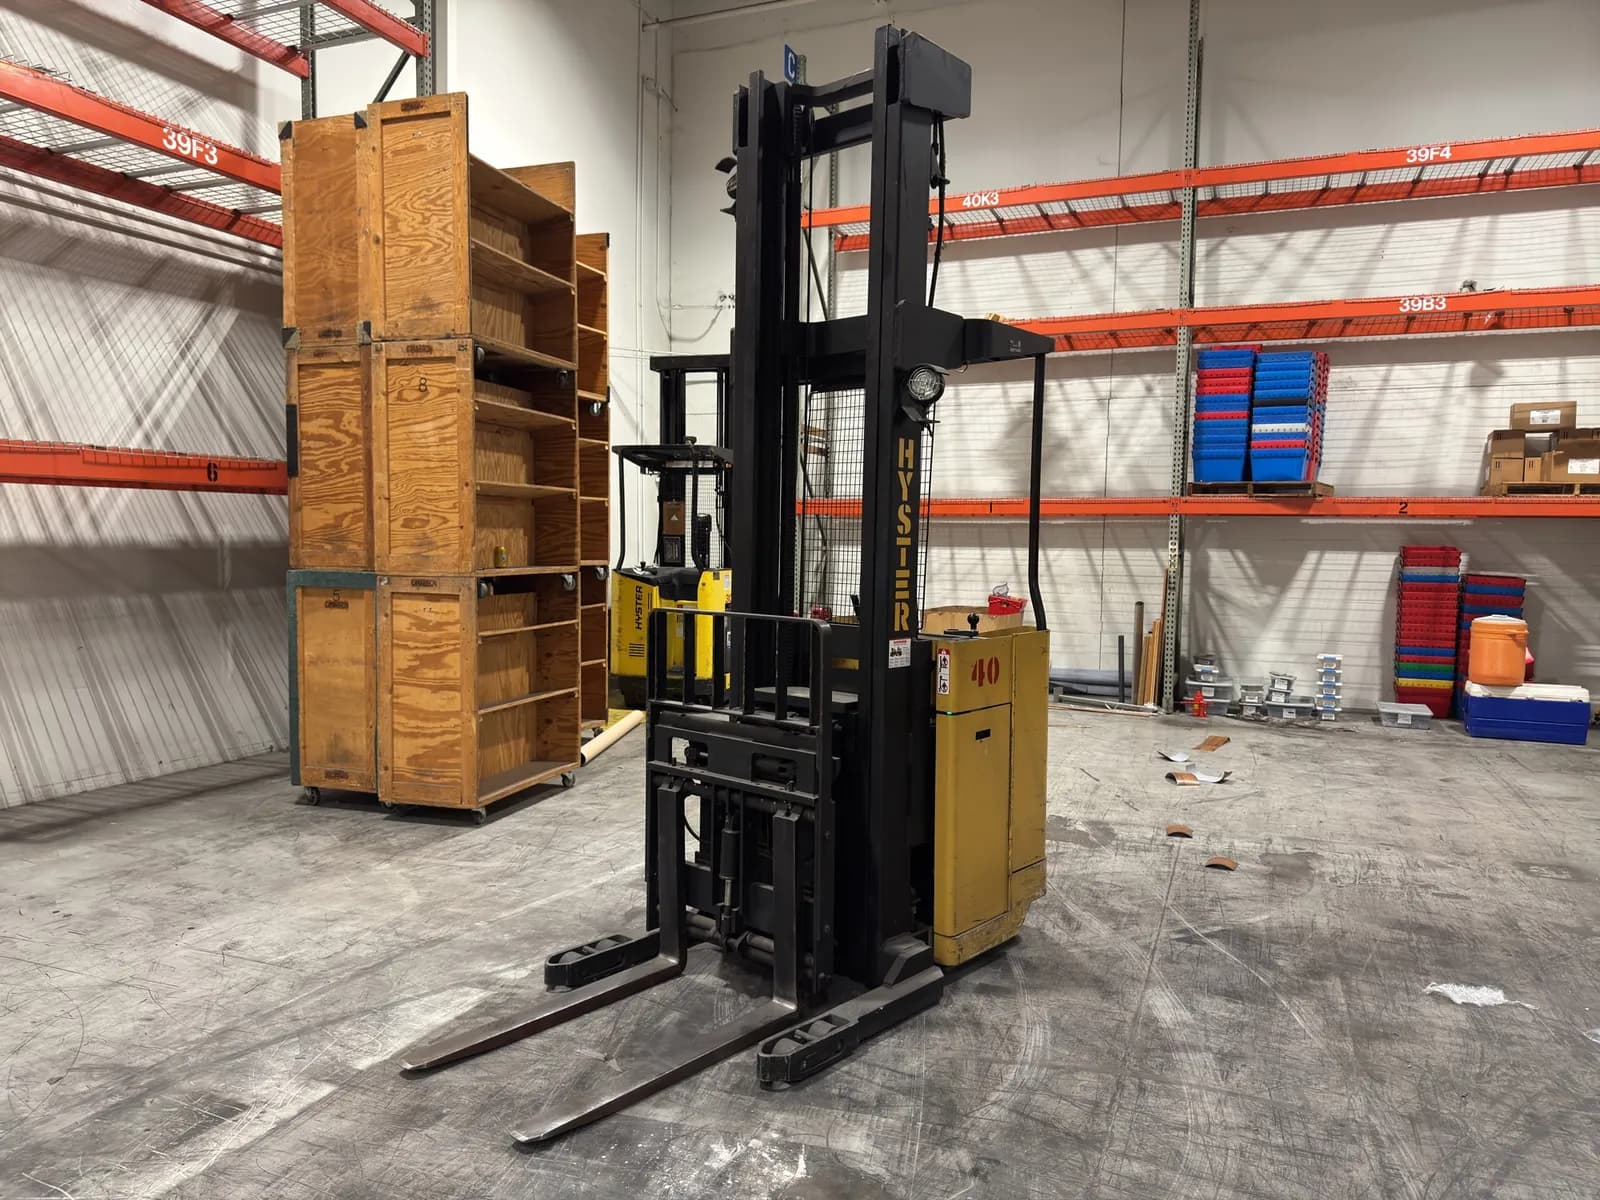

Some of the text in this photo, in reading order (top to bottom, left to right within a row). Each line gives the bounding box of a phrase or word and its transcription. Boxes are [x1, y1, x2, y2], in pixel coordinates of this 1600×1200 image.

[788, 52, 795, 79] C
[162, 126, 219, 165] 39F3
[1406, 146, 1452, 163] 39F4
[962, 191, 999, 208] 40K3
[1399, 296, 1447, 312] 39B3
[418, 377, 428, 393] 8
[207, 462, 218, 482] 6
[1399, 502, 1409, 515] 2
[894, 438, 915, 632] HYSTER
[634, 585, 643, 630] HYSTER
[971, 656, 1000, 687] 40
